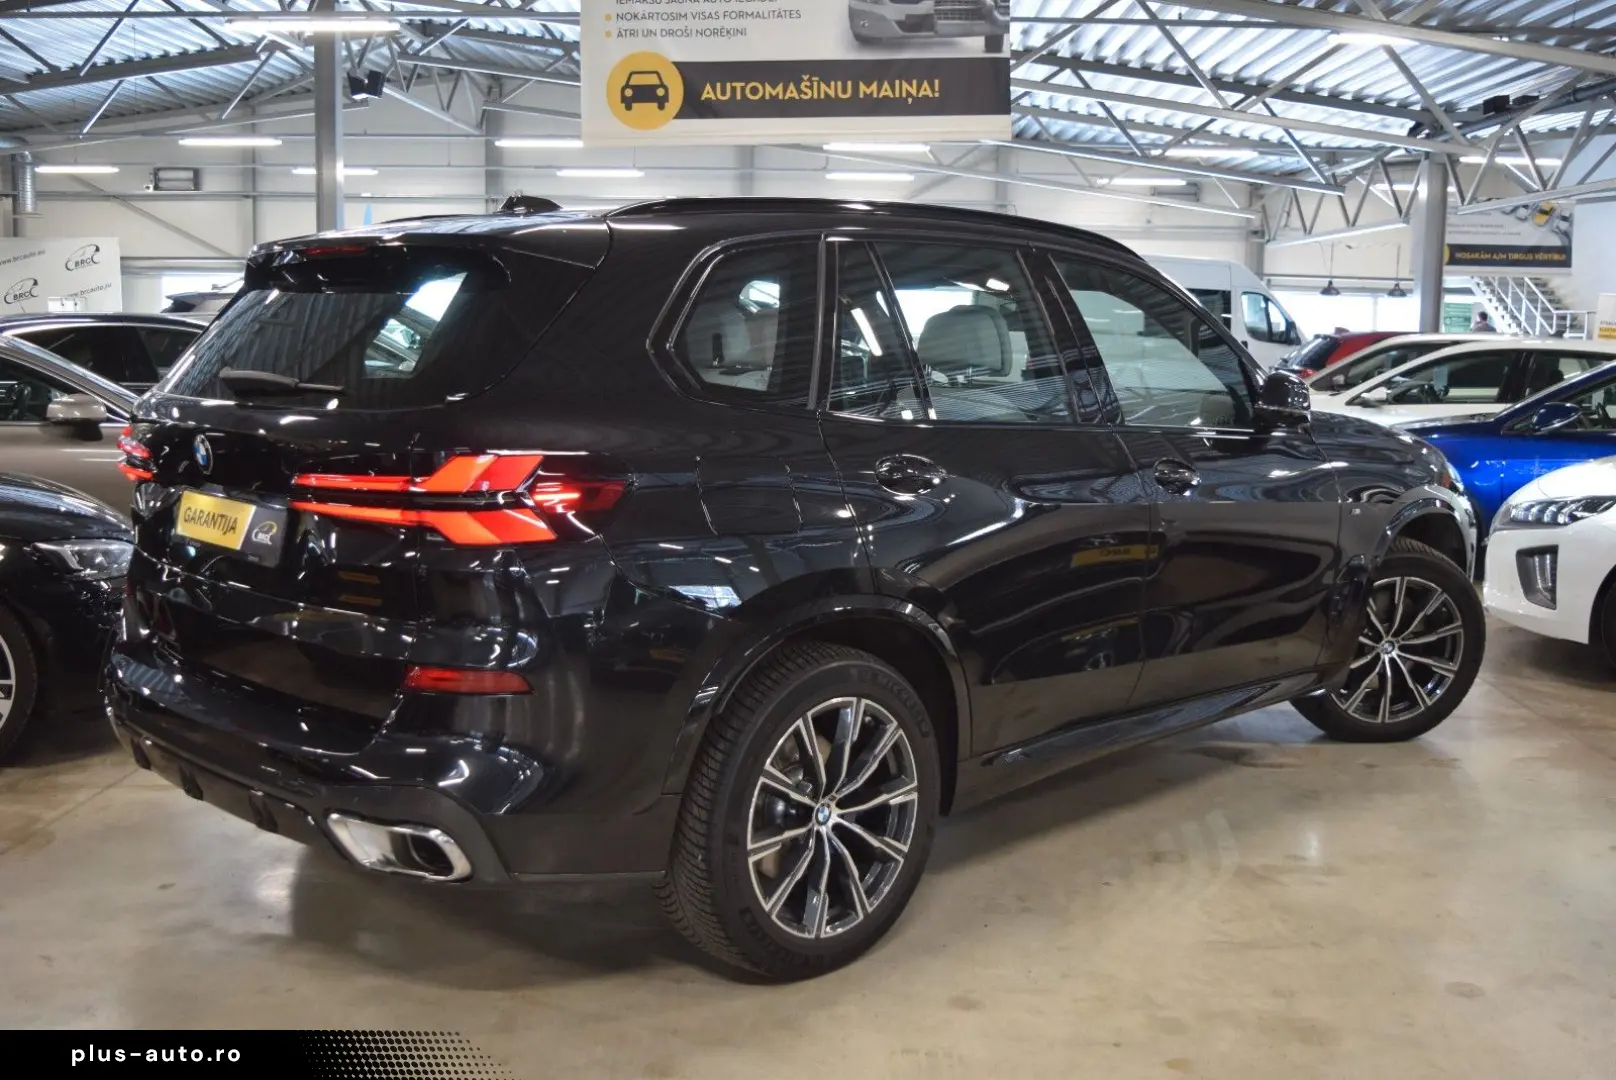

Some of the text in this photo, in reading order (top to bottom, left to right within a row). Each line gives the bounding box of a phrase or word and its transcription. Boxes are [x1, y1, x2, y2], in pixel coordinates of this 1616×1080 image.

[690, 11, 720, 21] VISAS
[641, 28, 657, 38] UN
[660, 25, 692, 38] DROŠI
[695, 25, 747, 40] NORĒĶINI
[701, 75, 940, 104] AUTOMAŠĪNU MAIŅA!
[13, 291, 30, 301] BRC
[184, 506, 239, 535] GARANTIJA
